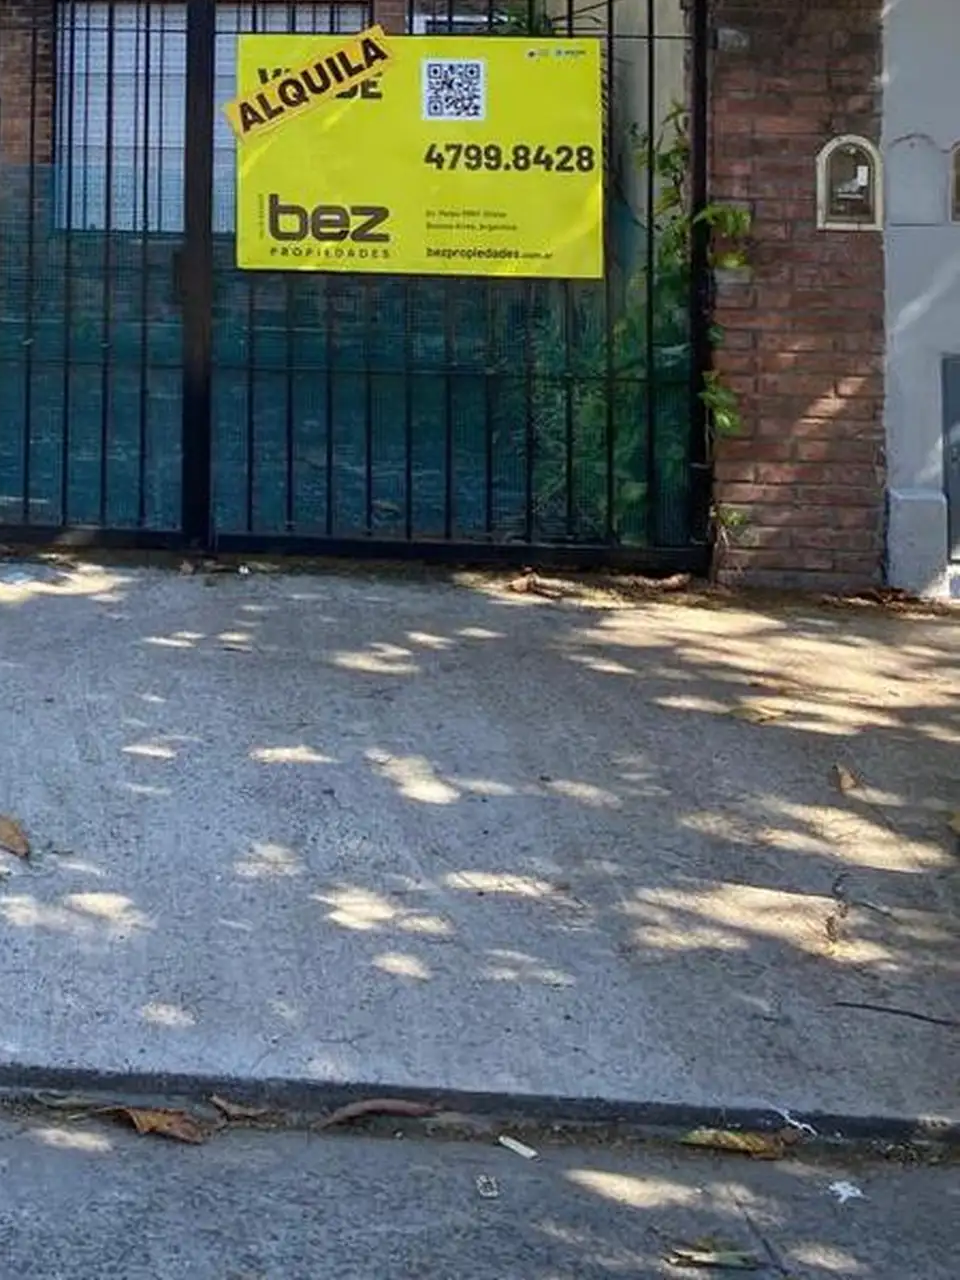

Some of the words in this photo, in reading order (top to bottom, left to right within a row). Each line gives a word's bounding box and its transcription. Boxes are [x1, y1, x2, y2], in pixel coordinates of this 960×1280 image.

[239, 37, 389, 133] ALQUILA
[424, 143, 595, 172] 4799.8428
[268, 193, 390, 242] bez
[270, 247, 390, 259] PROPIEDADES
